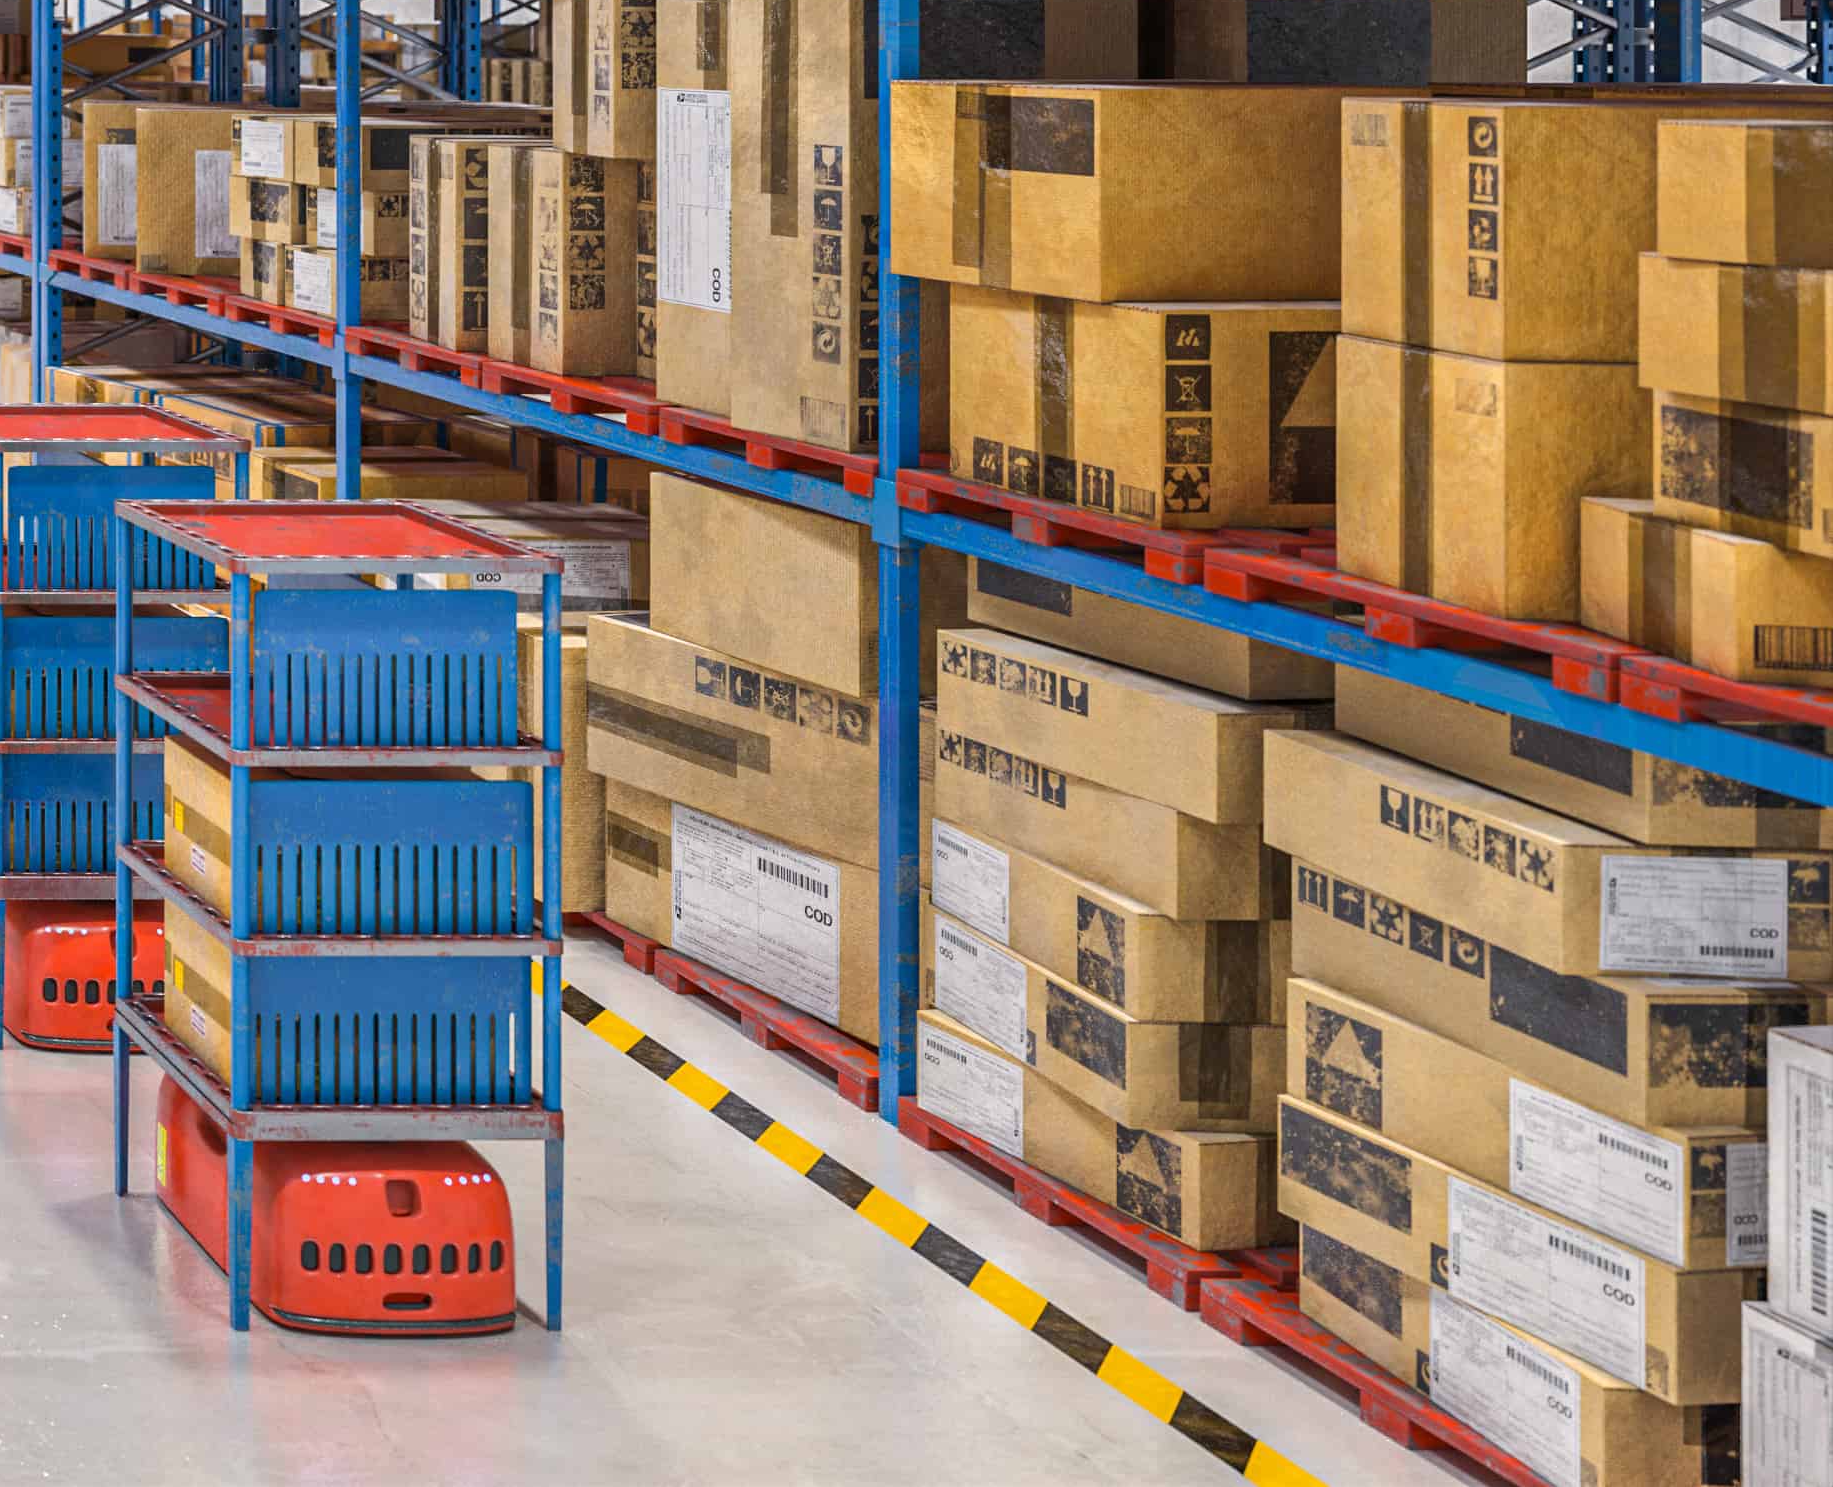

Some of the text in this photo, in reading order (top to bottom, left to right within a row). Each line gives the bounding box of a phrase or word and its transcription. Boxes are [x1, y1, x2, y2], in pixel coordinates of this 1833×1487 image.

[712, 267, 721, 303] COD
[804, 905, 833, 927] COD
[1750, 928, 1779, 939] COD
[1644, 1172, 1672, 1191] COD
[1603, 1283, 1635, 1307] COD
[1547, 1396, 1572, 1418] COD
